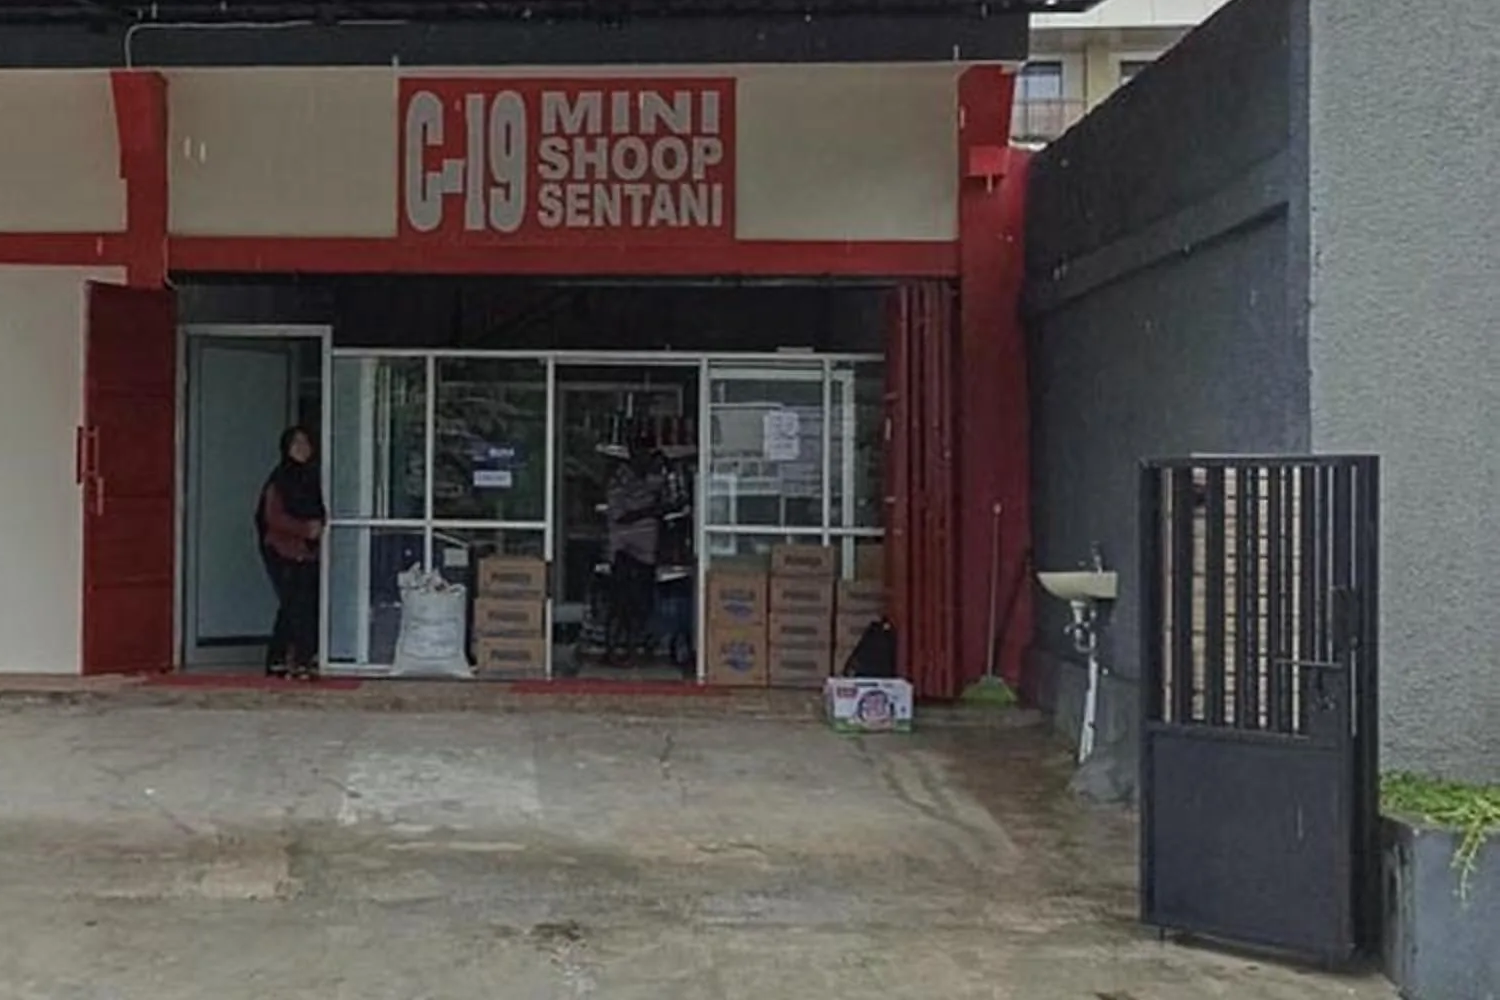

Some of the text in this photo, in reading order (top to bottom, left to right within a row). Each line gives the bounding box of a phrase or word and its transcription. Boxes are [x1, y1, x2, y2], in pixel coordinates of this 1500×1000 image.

[541, 90, 720, 134] MINI
[537, 136, 723, 180] SHOOP
[537, 183, 723, 227] SENTANI
